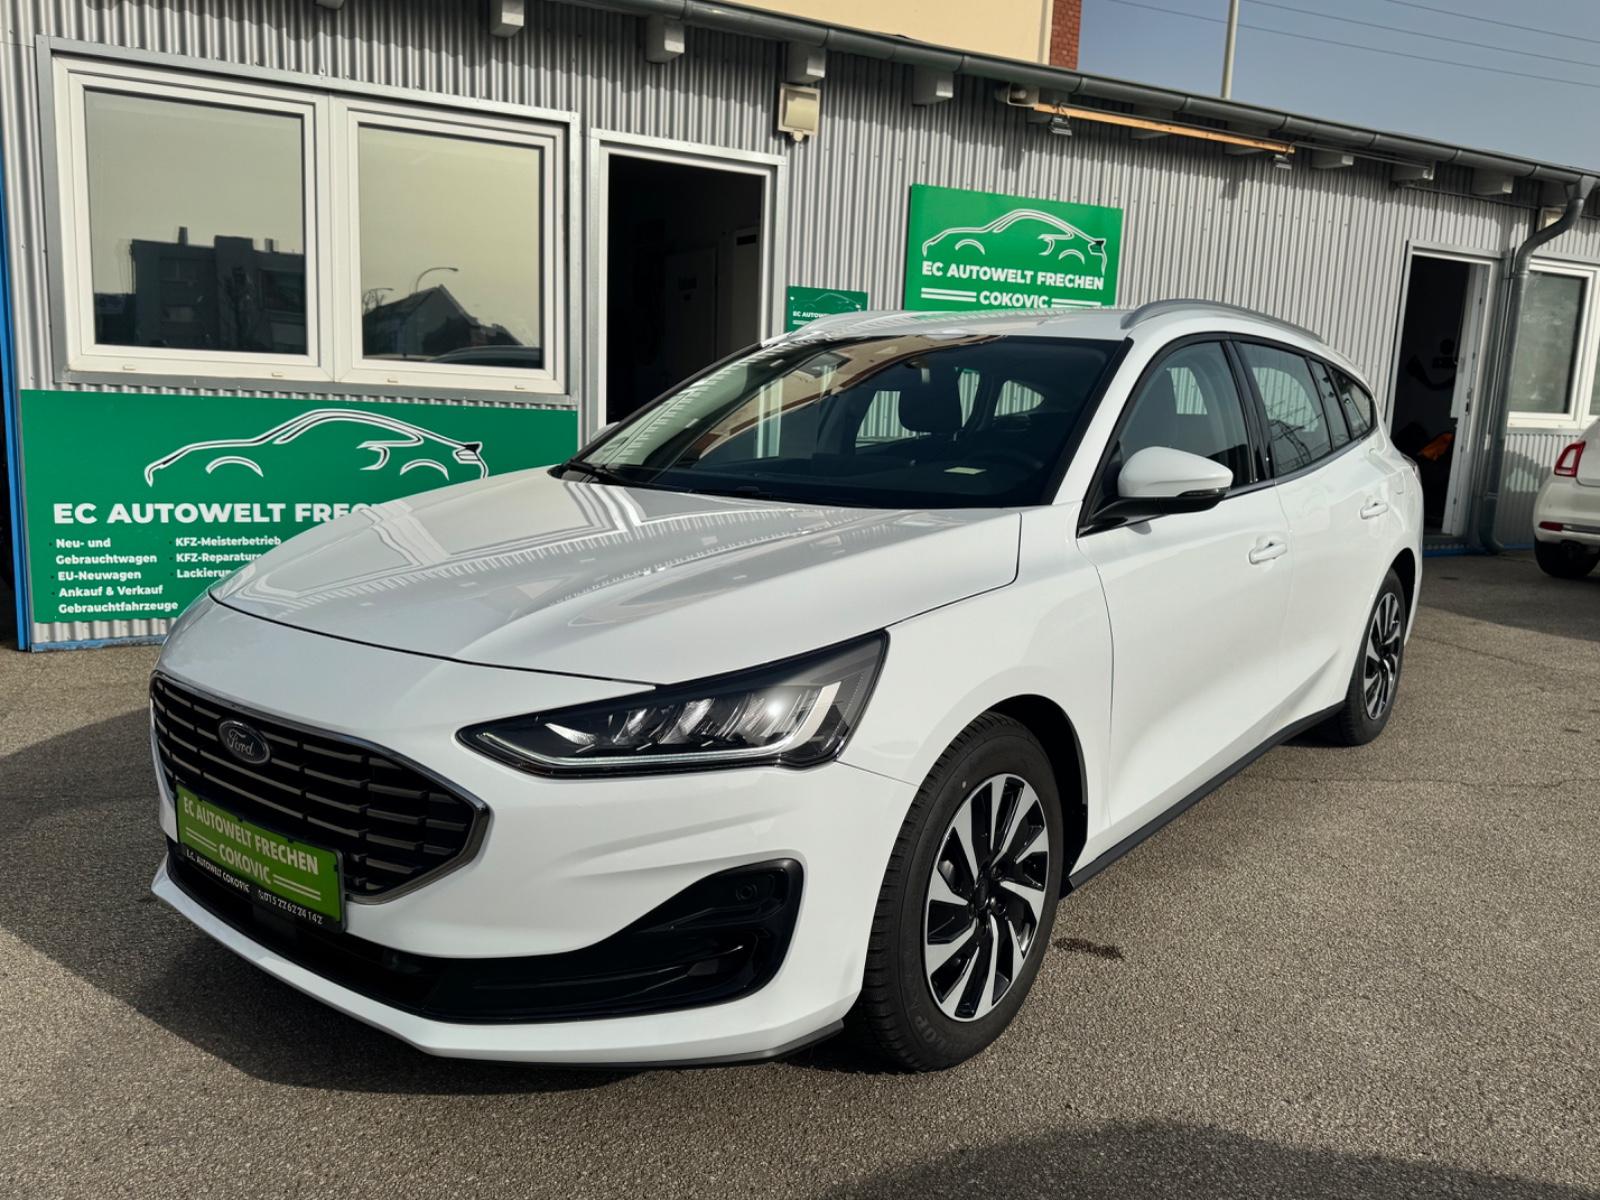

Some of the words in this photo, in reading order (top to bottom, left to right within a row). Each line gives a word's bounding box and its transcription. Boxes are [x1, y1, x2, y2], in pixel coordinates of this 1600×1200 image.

[922, 260, 943, 276] EC
[947, 263, 1034, 285] AUTOWELT
[1037, 271, 1105, 291] FRECHEN
[979, 290, 1049, 309] COKOVIC
[54, 502, 98, 524] EC
[106, 502, 287, 523] AUTOWELT
[55, 538, 85, 549] Neu-
[87, 537, 112, 548] und
[175, 535, 282, 547] KFZ-Meisterbetrieb
[55, 554, 158, 566] Gebrauchtwagen
[57, 571, 142, 582] EU-Neuwagen
[58, 586, 103, 597] Ankauf
[105, 586, 114, 596] &
[116, 584, 163, 595] Verkauf
[58, 601, 179, 614] Gebrauchtfahrzeuge
[226, 728, 255, 757] Ford
[183, 796, 195, 818] EC
[196, 807, 252, 849] AUTOWELT
[253, 834, 320, 876] FRECHEN
[218, 843, 272, 885] COKOVIC
[222, 871, 251, 894] COKOVIC
